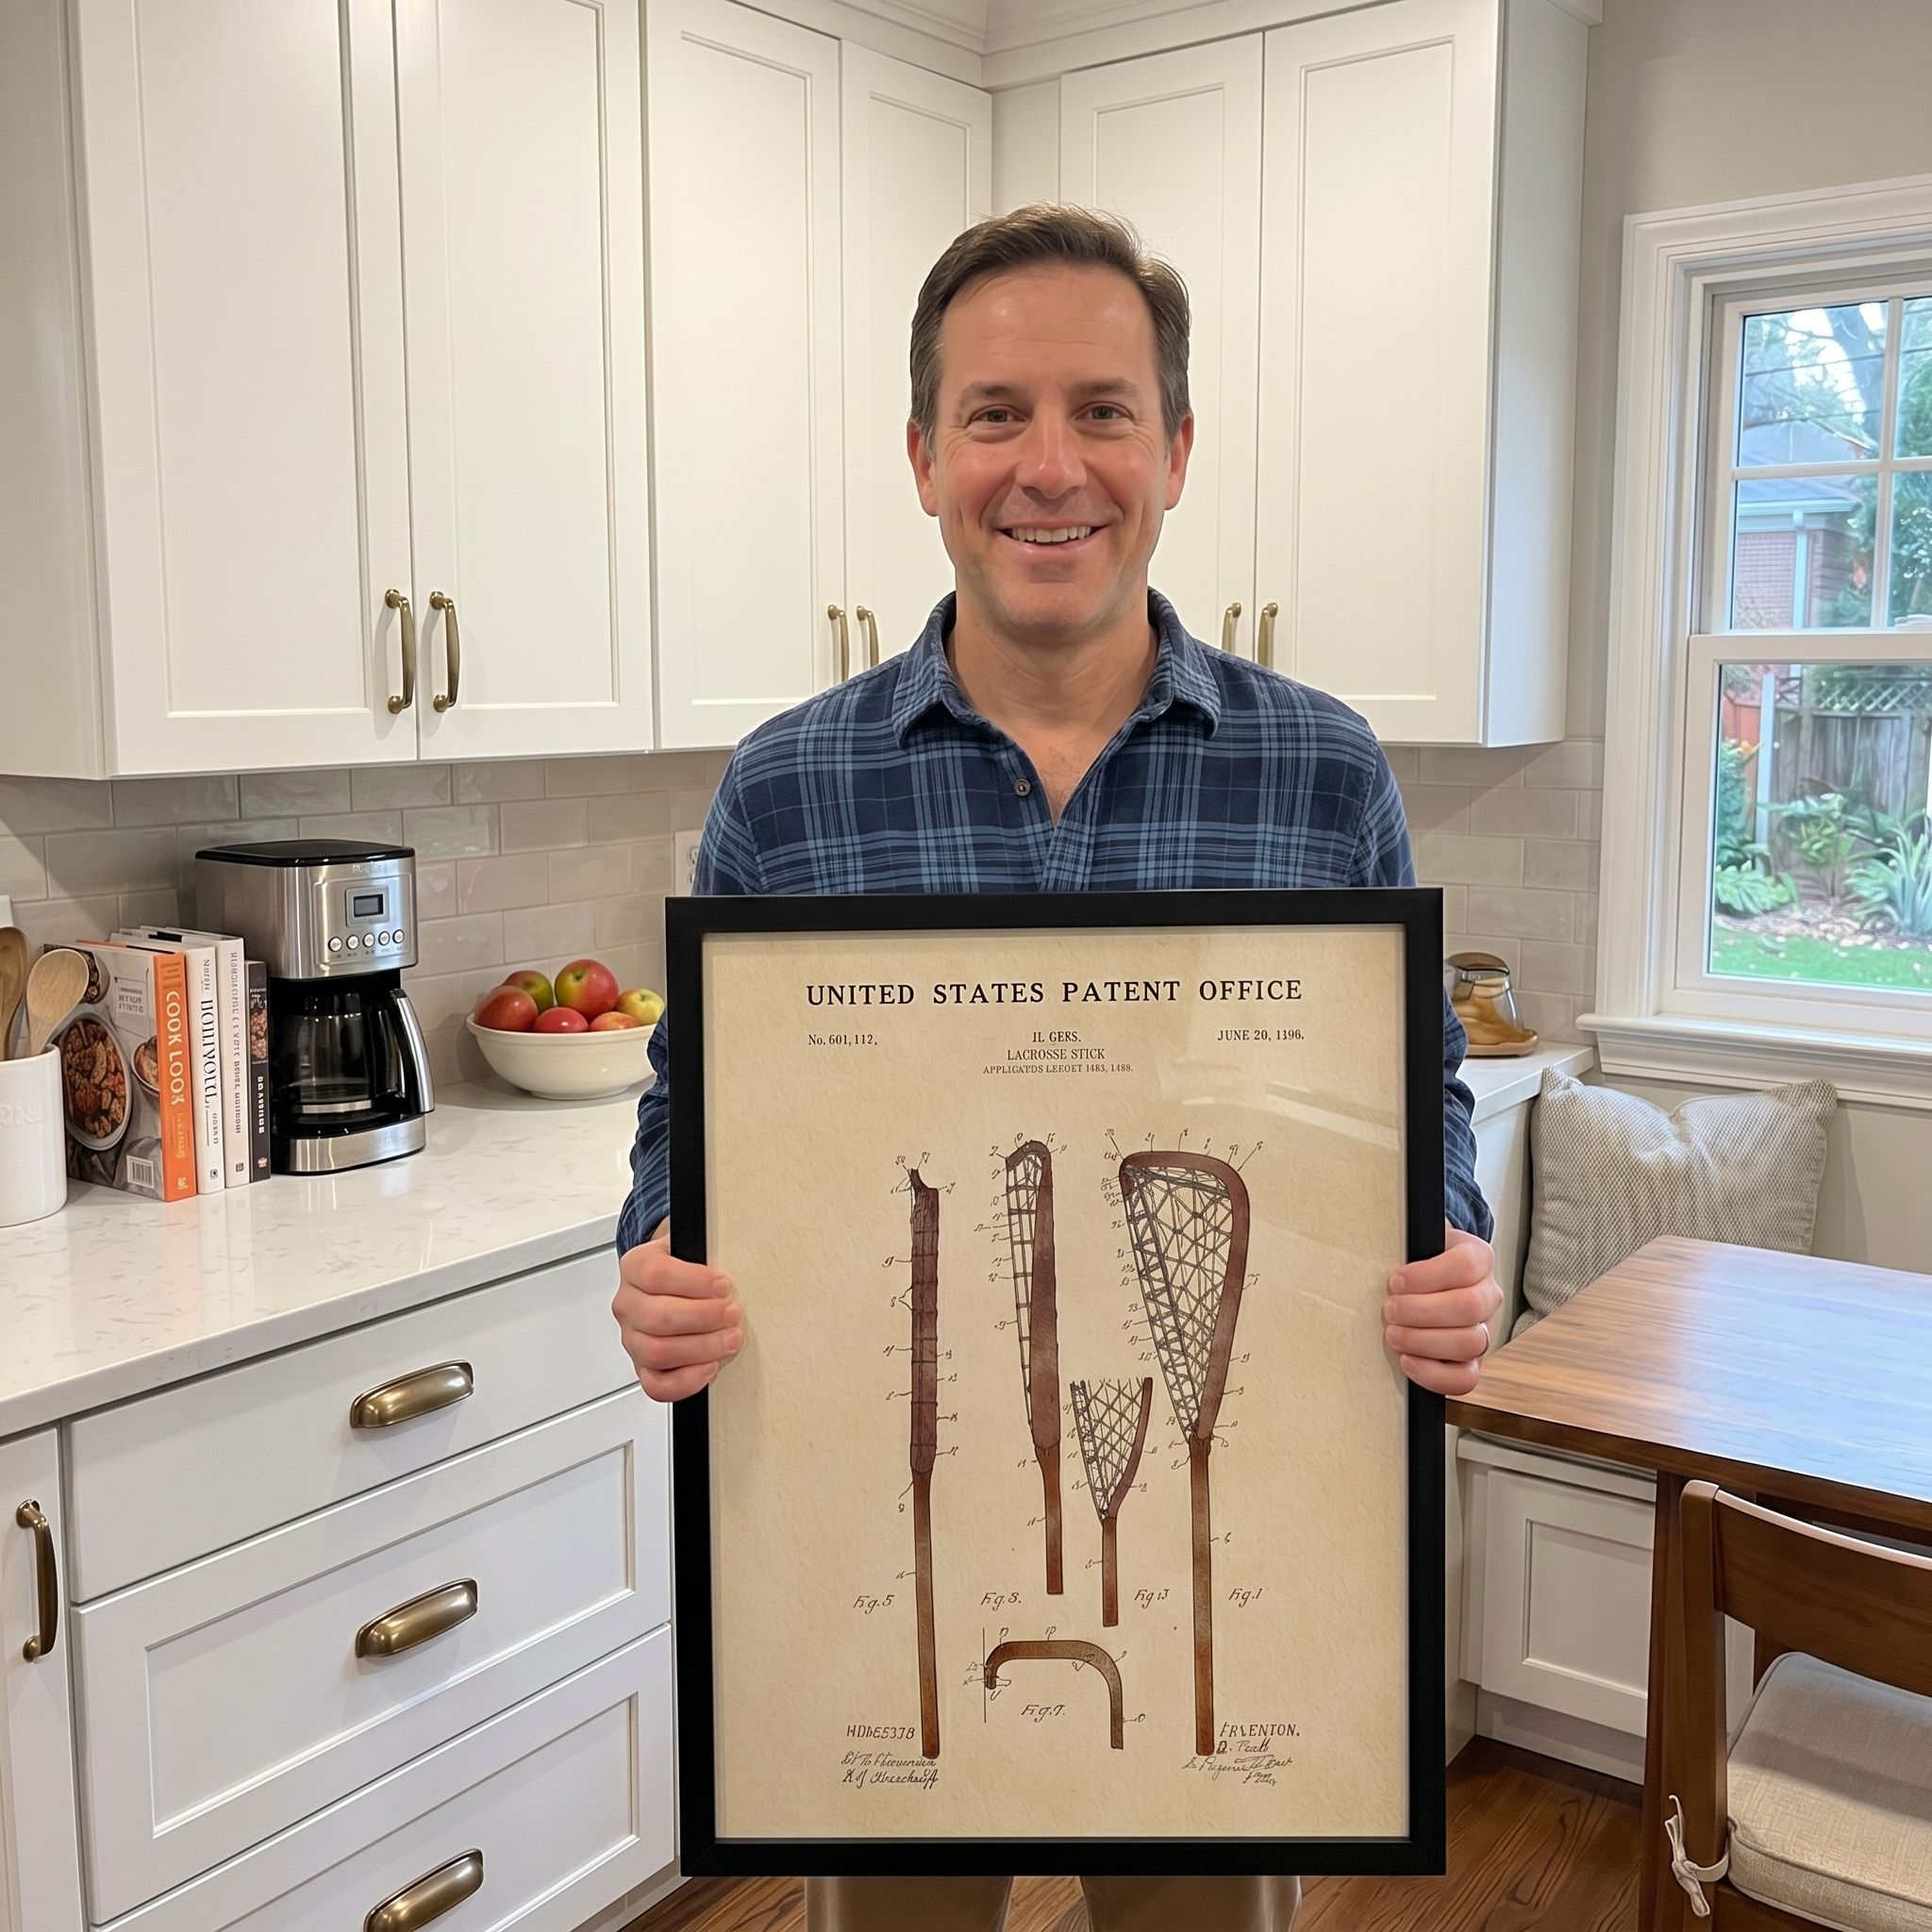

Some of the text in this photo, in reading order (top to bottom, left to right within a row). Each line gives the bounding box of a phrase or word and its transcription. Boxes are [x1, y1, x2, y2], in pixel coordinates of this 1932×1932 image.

[806, 979, 1302, 1006] UNITED STATES PATENT OFFICE
[166, 991, 183, 1047] COOK
[808, 1034, 826, 1045] No.
[1217, 1029, 1250, 1041] JUNE
[1254, 1029, 1272, 1042] 20,
[1007, 1048, 1106, 1061] LACROSSE STICK
